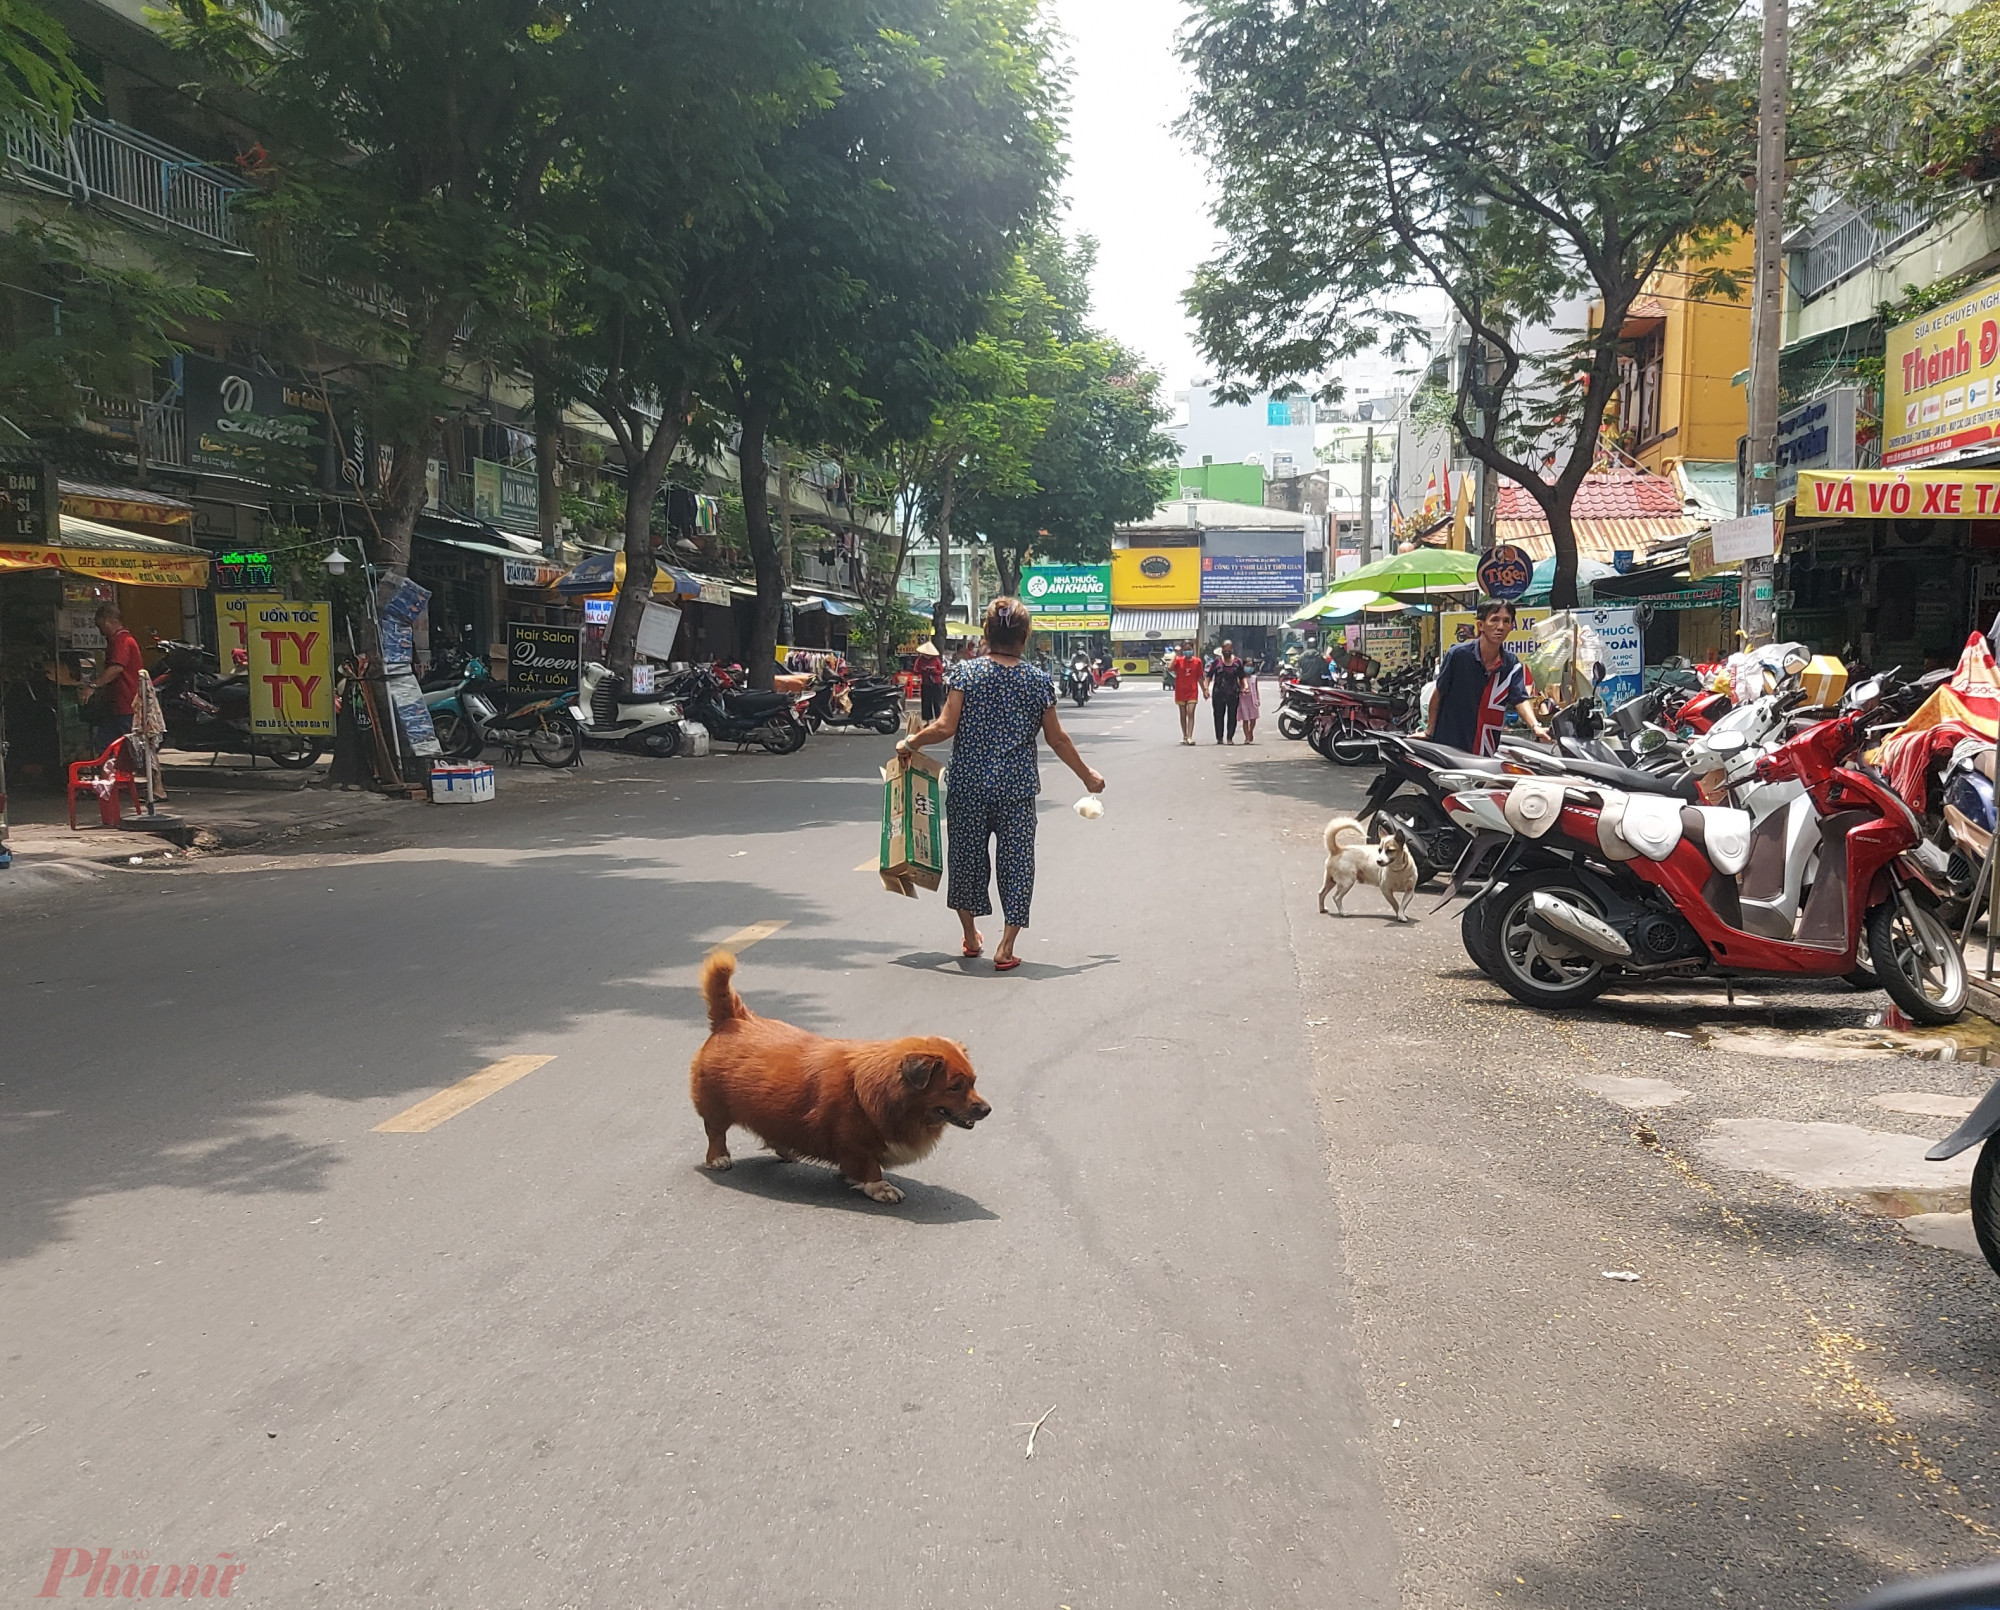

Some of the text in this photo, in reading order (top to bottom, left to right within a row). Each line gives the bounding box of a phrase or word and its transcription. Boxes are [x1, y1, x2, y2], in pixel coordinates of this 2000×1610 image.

[1932, 317, 1942, 332] XE
[1944, 301, 1978, 327] CHUYÊN
[1902, 319, 2000, 395] Thành Đ
[516, 484, 537, 508] TRANG
[1814, 475, 1854, 513] VÁ
[1868, 474, 1911, 514] VỎ
[1921, 483, 1963, 514] XE
[78, 556, 96, 567] CAFE
[222, 551, 268, 564] UỐN TÓC
[1214, 562, 1230, 571] CÔNG
[217, 564, 272, 584] TY TY
[1053, 574, 1098, 584] NHÀ THUỐC
[1486, 566, 1525, 587] Tiger
[1047, 583, 1104, 593] AN KHANG
[259, 607, 320, 623] UỐN TÓC
[516, 628, 575, 643] Hair Salon
[1595, 624, 1635, 636] THUỐC
[260, 631, 320, 665] TY
[512, 641, 578, 671] Queen
[518, 670, 568, 685] CẮT, UỐN
[262, 675, 321, 709] TY
